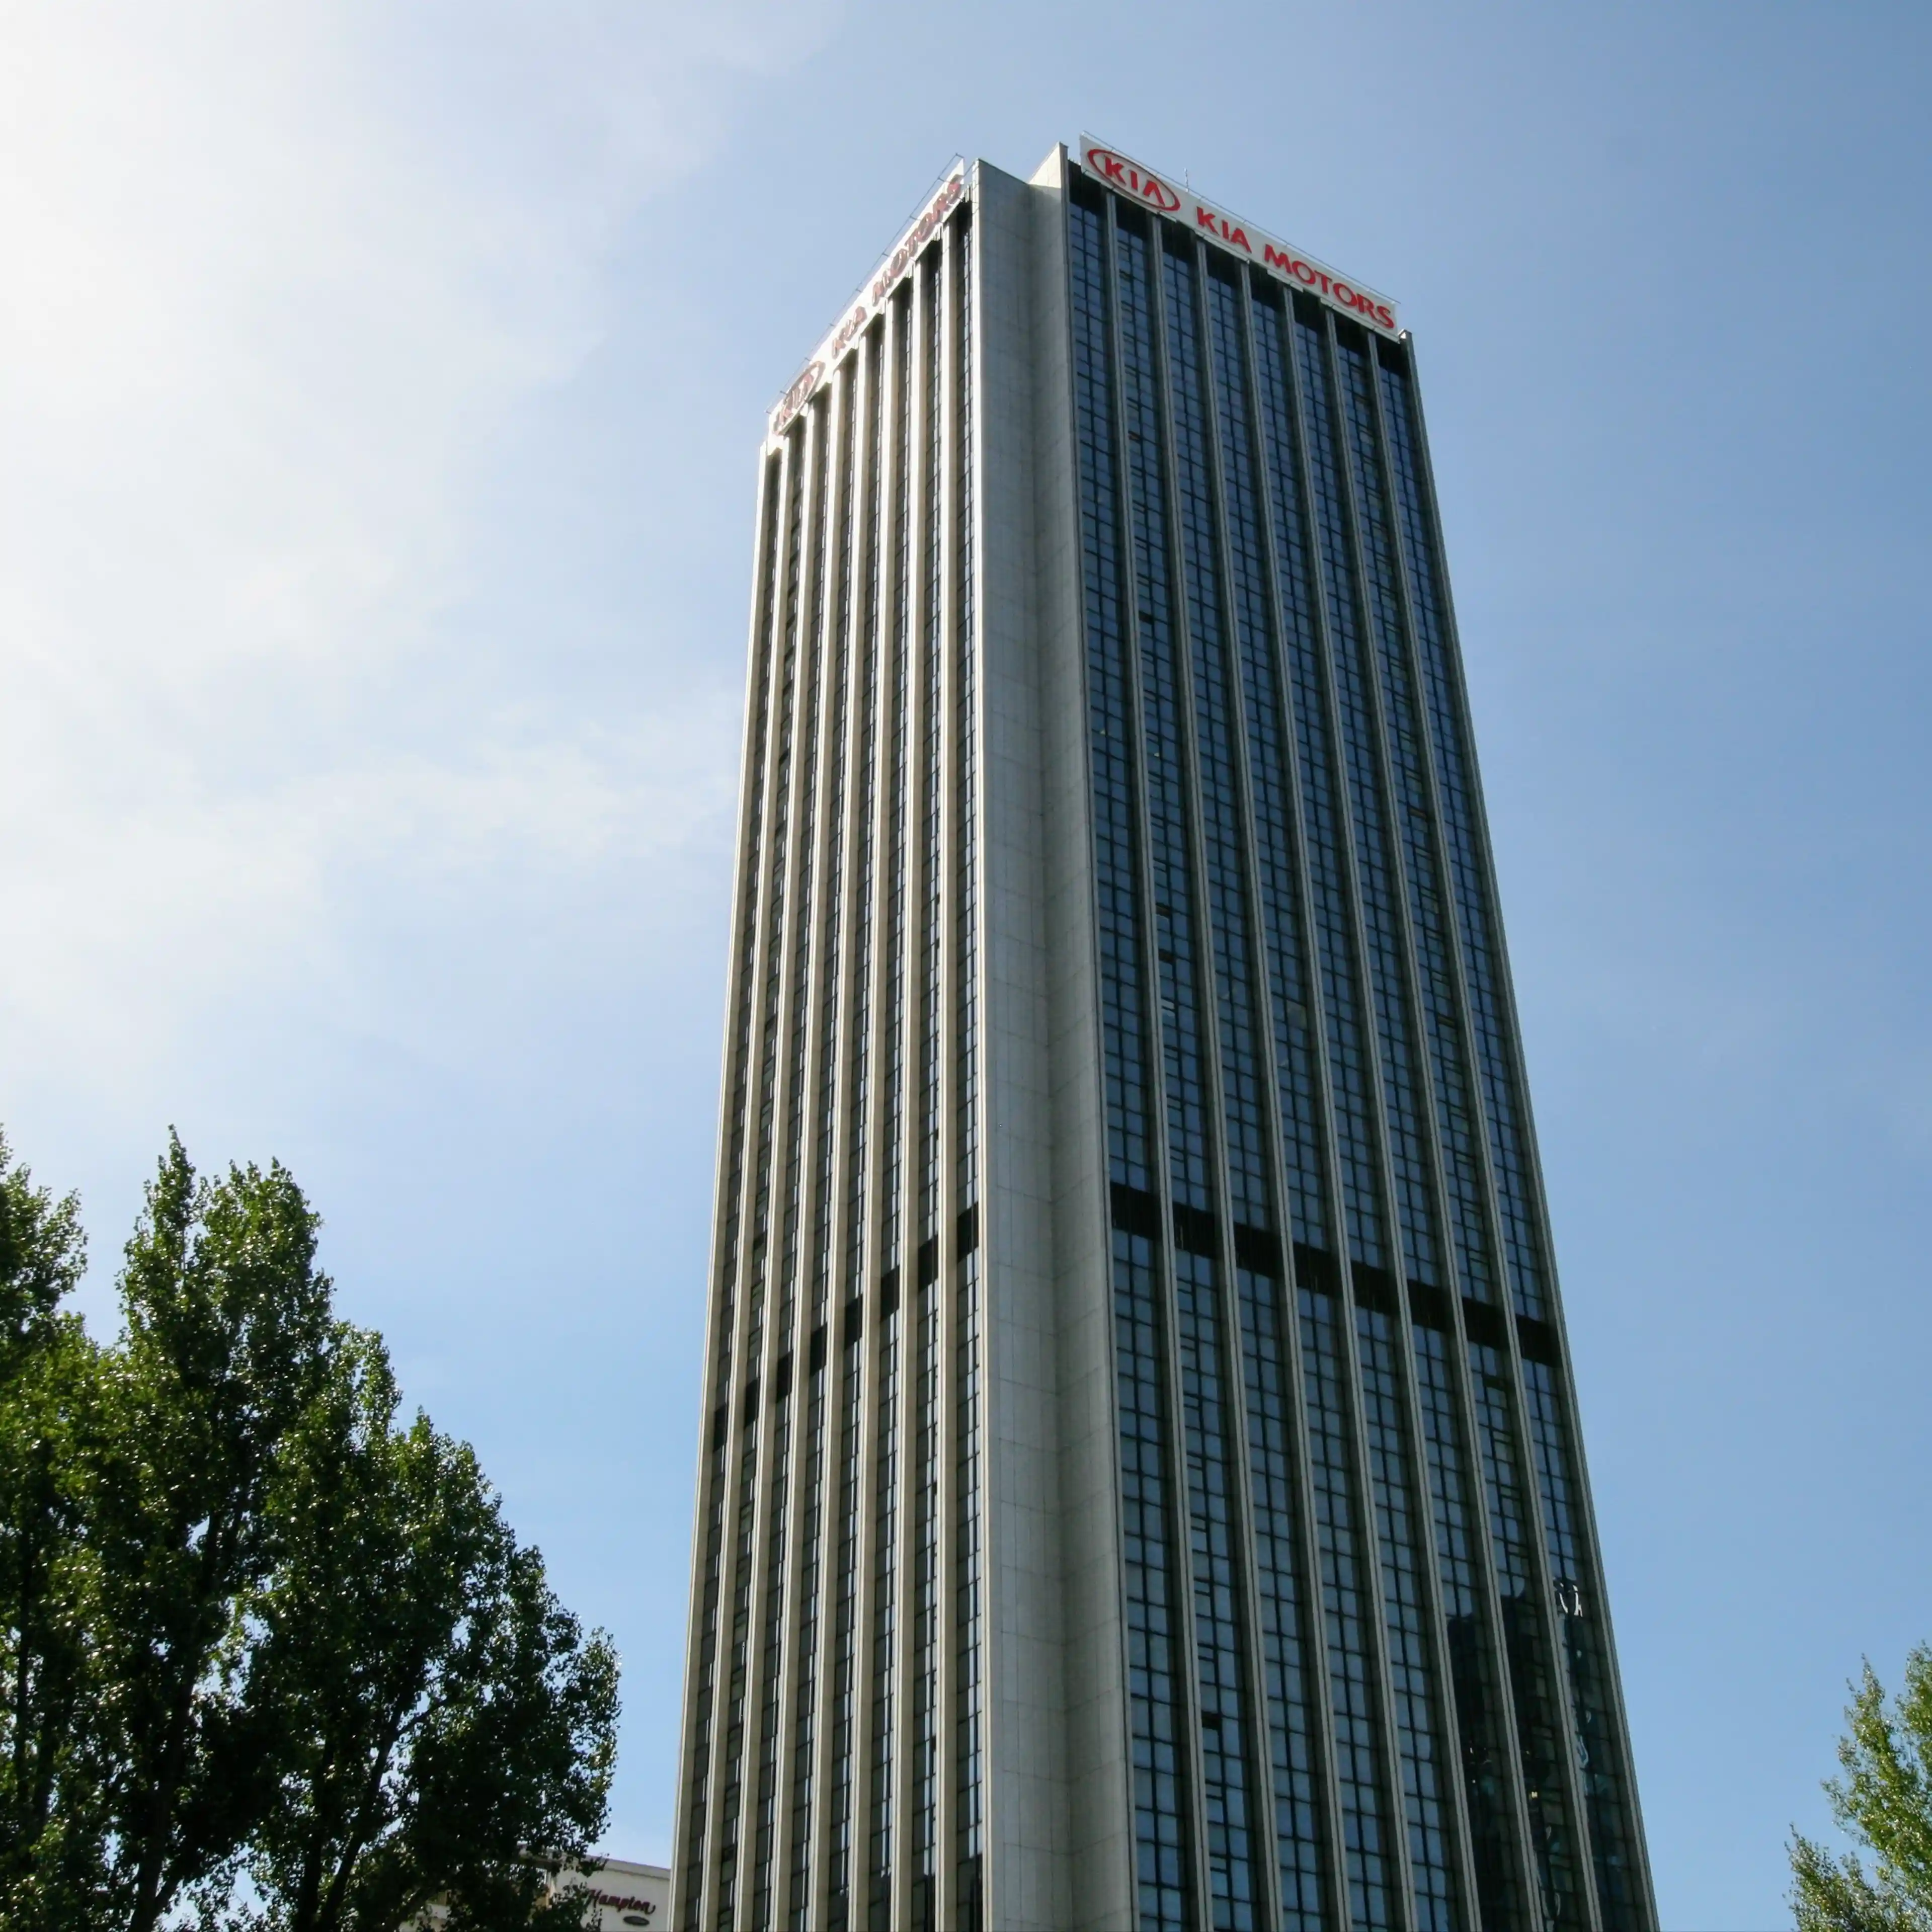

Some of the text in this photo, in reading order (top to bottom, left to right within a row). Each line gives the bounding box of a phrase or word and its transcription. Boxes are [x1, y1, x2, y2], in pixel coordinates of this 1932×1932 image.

[1104, 156, 1165, 208] KIA
[872, 174, 961, 306] MOTORS
[1196, 206, 1395, 329] KIA MOTORS
[587, 1889, 656, 1915] Hampton
